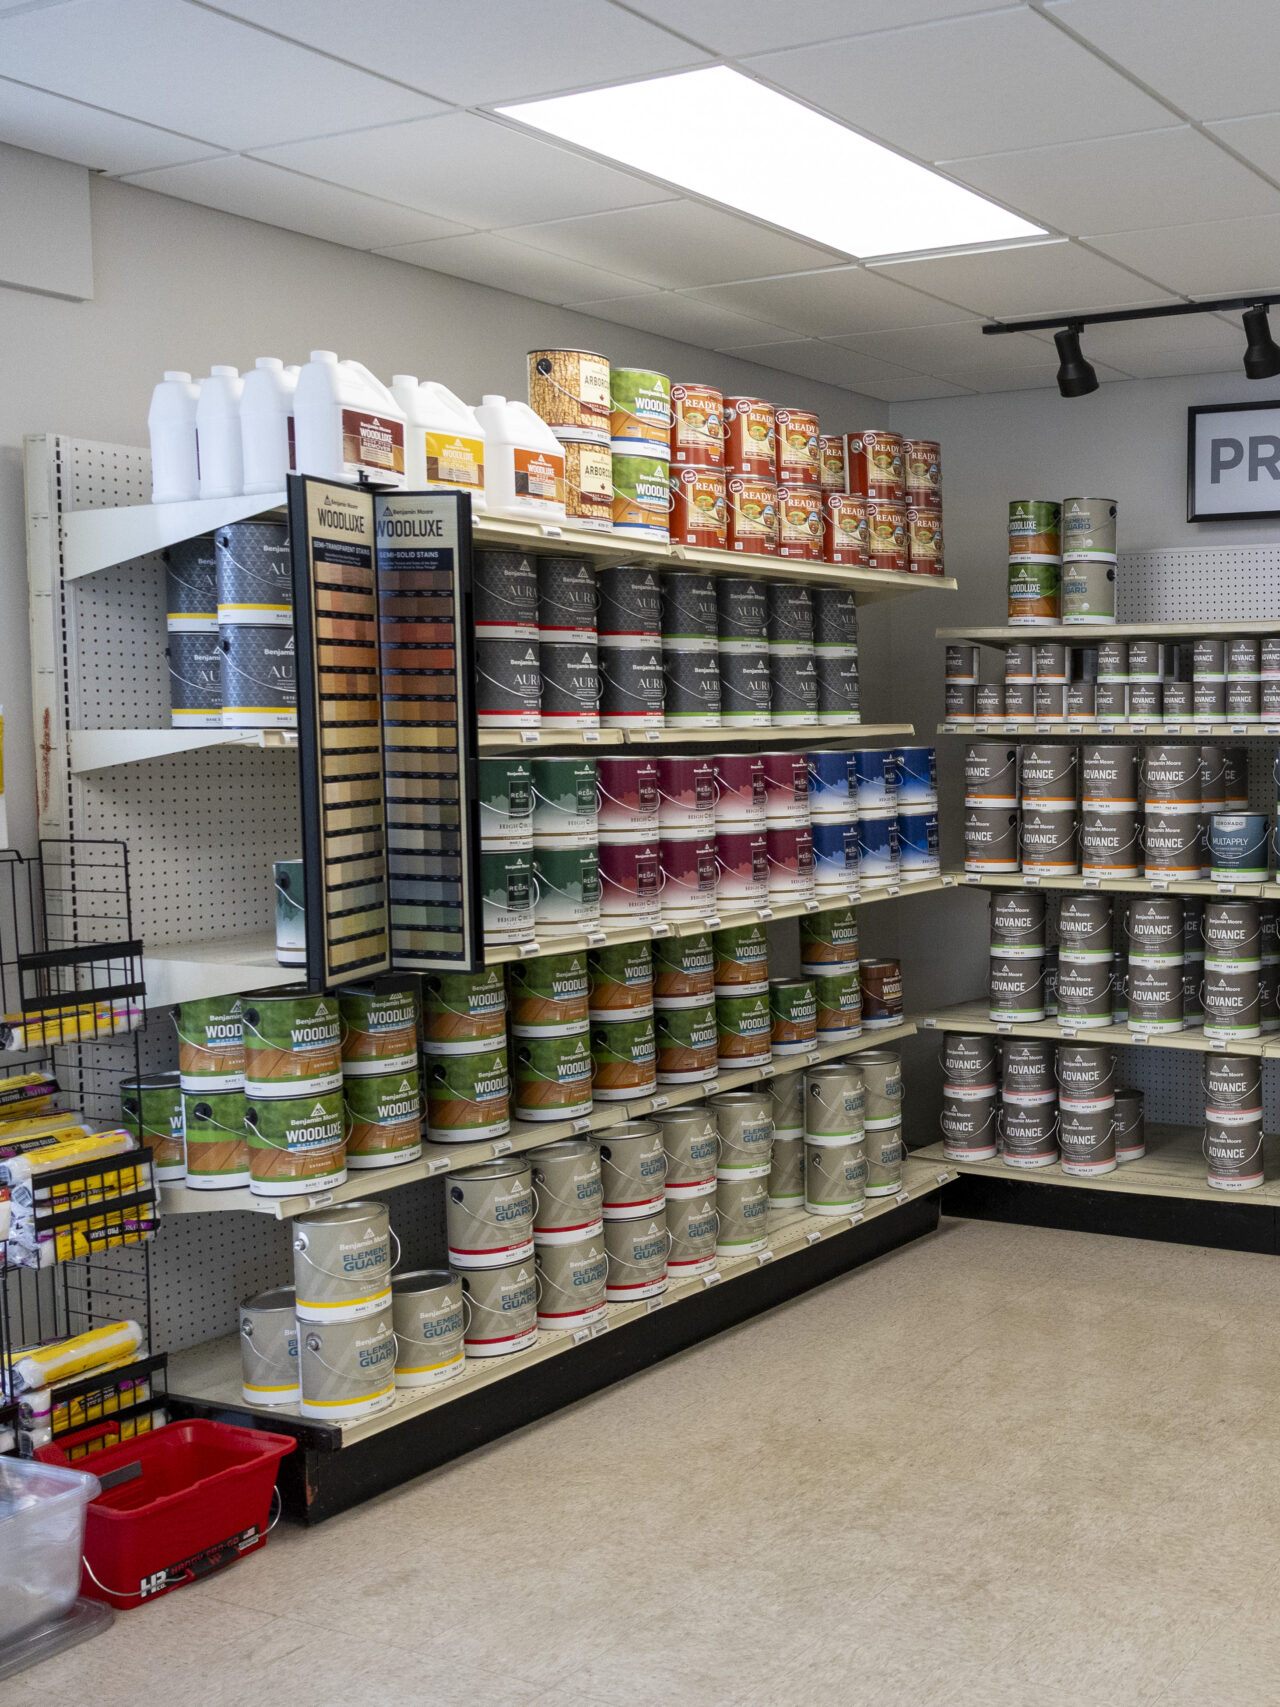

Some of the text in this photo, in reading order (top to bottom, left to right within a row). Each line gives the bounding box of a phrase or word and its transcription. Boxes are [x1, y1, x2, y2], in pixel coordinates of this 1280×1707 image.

[685, 399, 715, 409] READY
[789, 423, 815, 431] READY
[360, 428, 392, 443] WOODLUXE
[743, 492, 770, 500] READY
[789, 499, 815, 508] READY
[318, 508, 364, 533] WOODLUXE
[376, 520, 443, 537] WOODLUXE
[1084, 769, 1118, 780] ADVANCE
[1147, 771, 1184, 781] ADVANCE
[1024, 834, 1058, 844] ADVANCE
[1147, 838, 1184, 848] ADVANCE
[995, 917, 1032, 928] ADVANCE
[1134, 925, 1173, 935] ADVANCE
[1208, 929, 1246, 940] ADVANCE
[1060, 987, 1094, 997] ADVANCE
[1133, 991, 1171, 1001] ADVANCE
[1206, 997, 1243, 1007] ADVANCE
[367, 1006, 414, 1024] WOODLUXE
[1008, 1064, 1047, 1075] ADVANCE
[1062, 1070, 1101, 1081] ADVANCE
[1208, 1081, 1248, 1092] ADVANCE
[291, 1116, 322, 1126] Benjamin
[286, 1123, 341, 1143] WOODLUXE
[1208, 1147, 1245, 1159] ADVANCE
[340, 1238, 372, 1250] Benjamin
[344, 1254, 388, 1272] GUARD
[423, 1317, 462, 1339] GUARD
